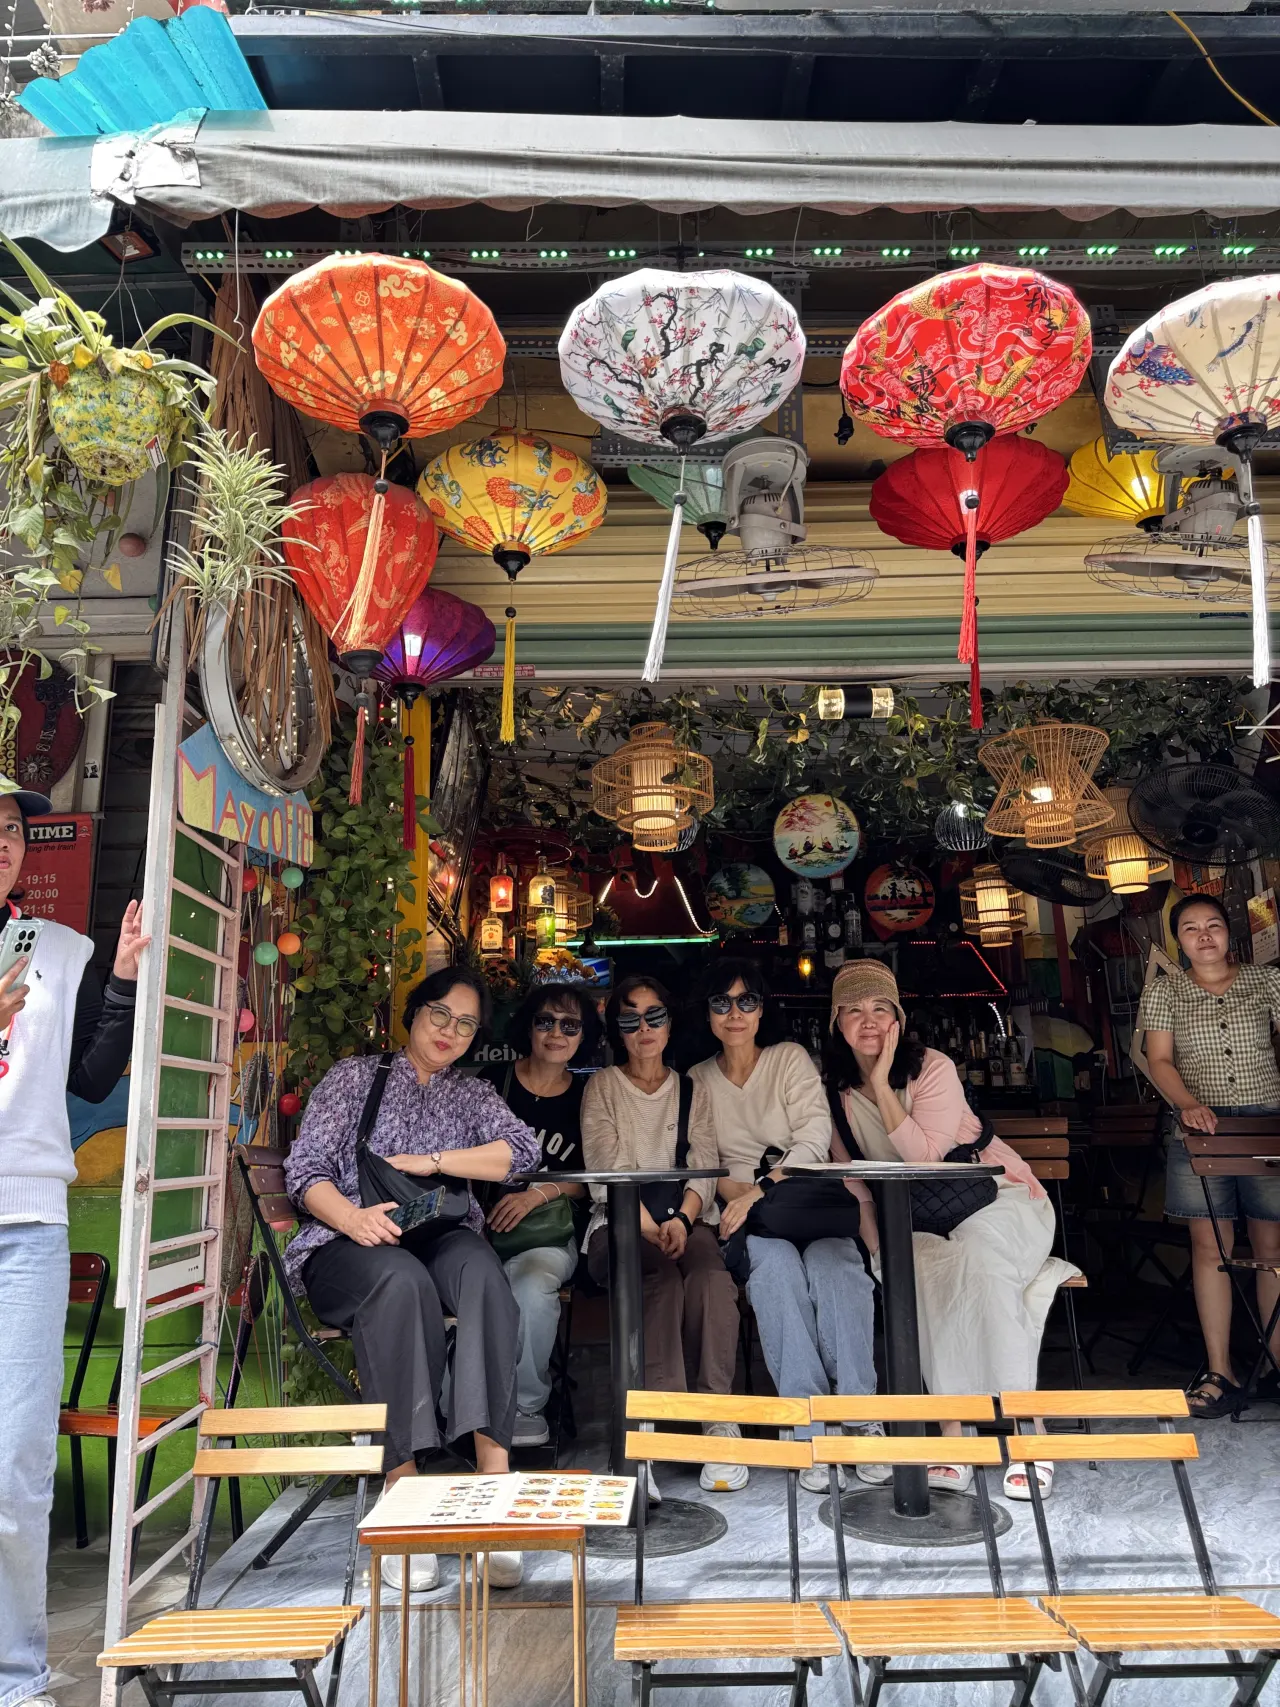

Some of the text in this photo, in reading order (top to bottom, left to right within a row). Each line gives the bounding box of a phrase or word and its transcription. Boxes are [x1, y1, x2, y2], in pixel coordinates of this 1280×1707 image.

[29, 825, 74, 840] TIME
[26, 874, 56, 885] 19:15
[27, 888, 58, 900] 20:00
[23, 904, 55, 914] 21:15
